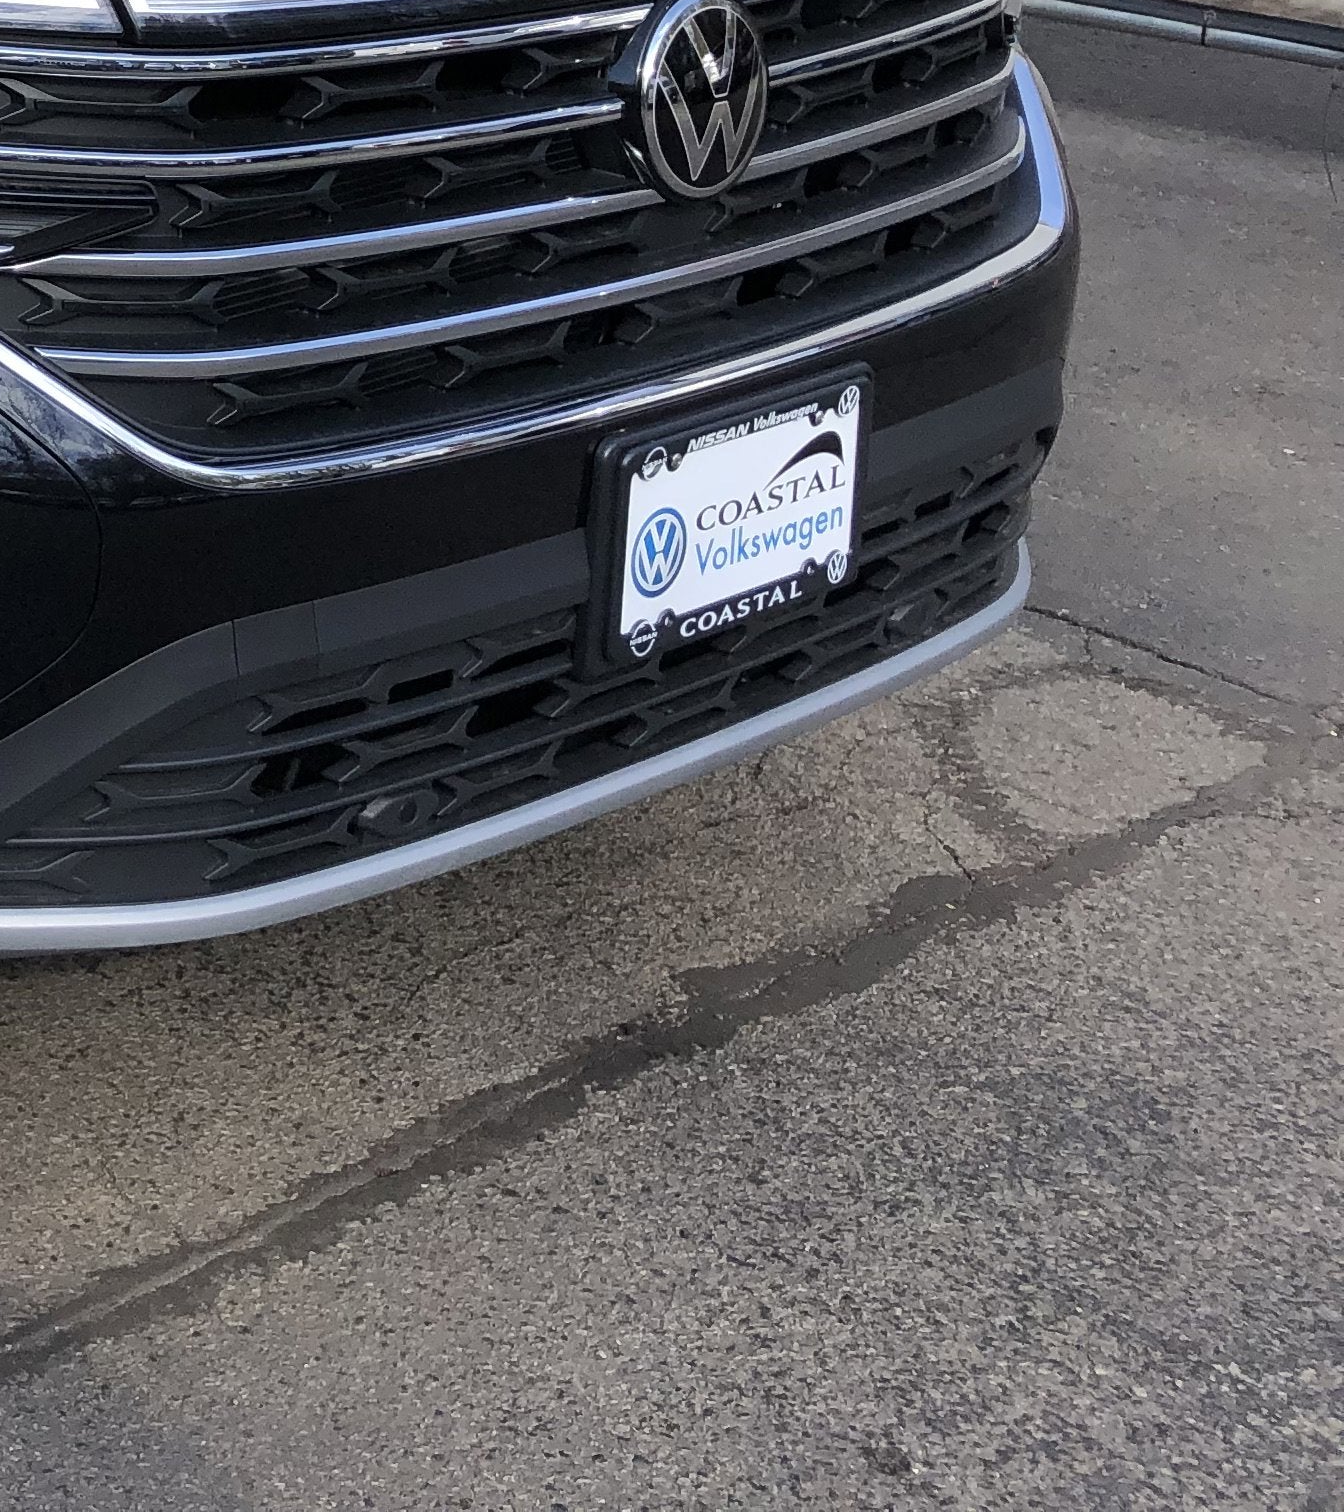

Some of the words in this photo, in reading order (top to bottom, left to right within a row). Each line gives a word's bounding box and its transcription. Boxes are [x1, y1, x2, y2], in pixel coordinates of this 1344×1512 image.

[687, 420, 751, 454] NISSAN
[753, 402, 819, 432] Volkswagen
[695, 464, 846, 531] COASTAL
[695, 505, 843, 576] Volkswagen
[679, 579, 803, 638] COASTAL
